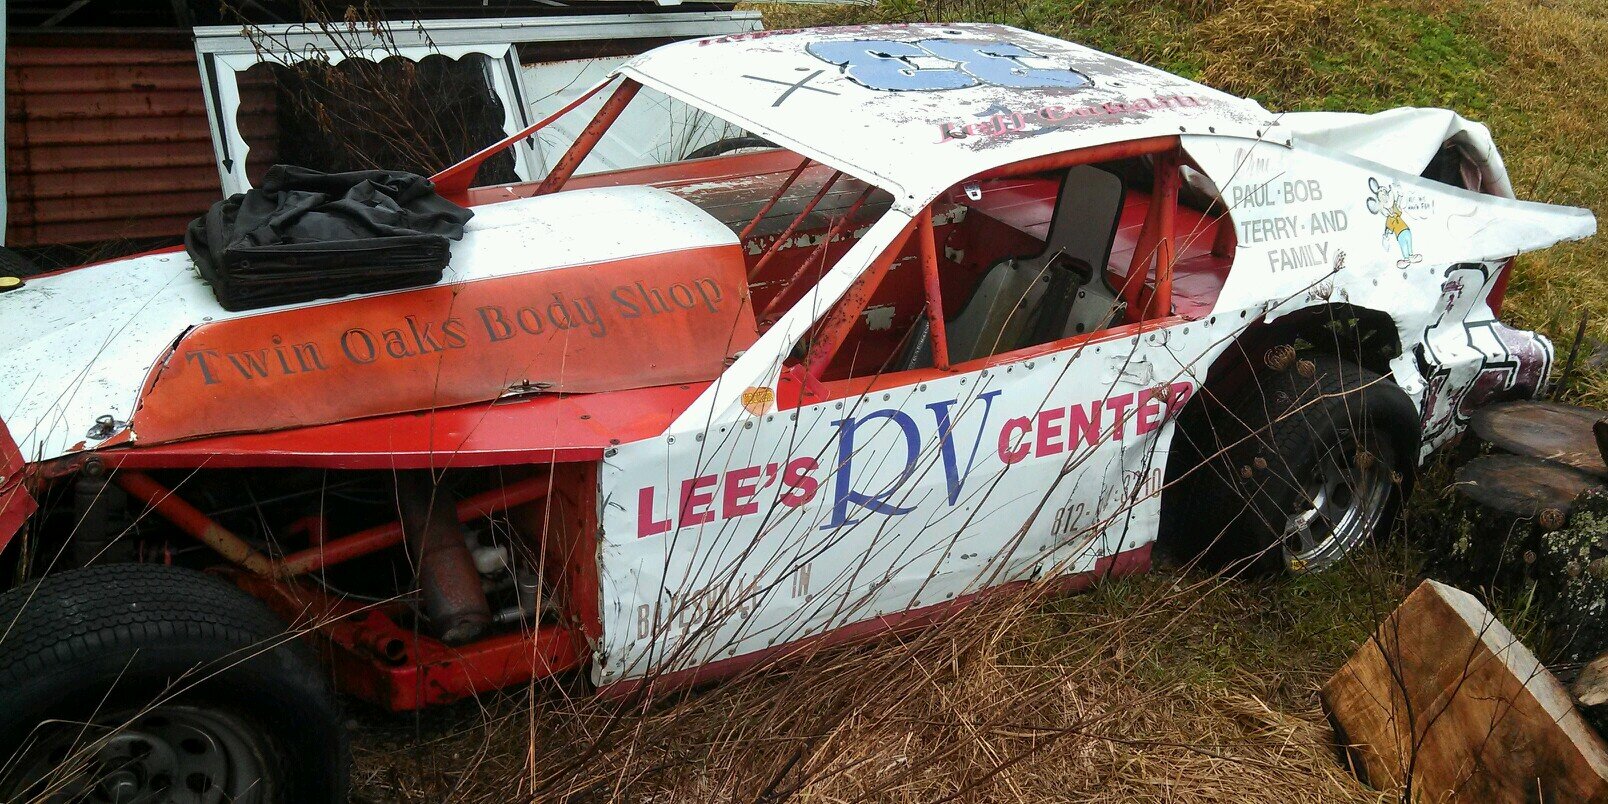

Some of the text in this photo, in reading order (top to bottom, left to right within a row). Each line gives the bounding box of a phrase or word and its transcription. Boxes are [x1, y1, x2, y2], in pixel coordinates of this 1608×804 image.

[1283, 179, 1323, 204] BOB
[1240, 208, 1349, 244] TERRY AND
[1266, 241, 1330, 274] FAMILY
[185, 274, 724, 386] Twin Oaks Body Shop
[636, 380, 1195, 539] LEE'S RV CENTER
